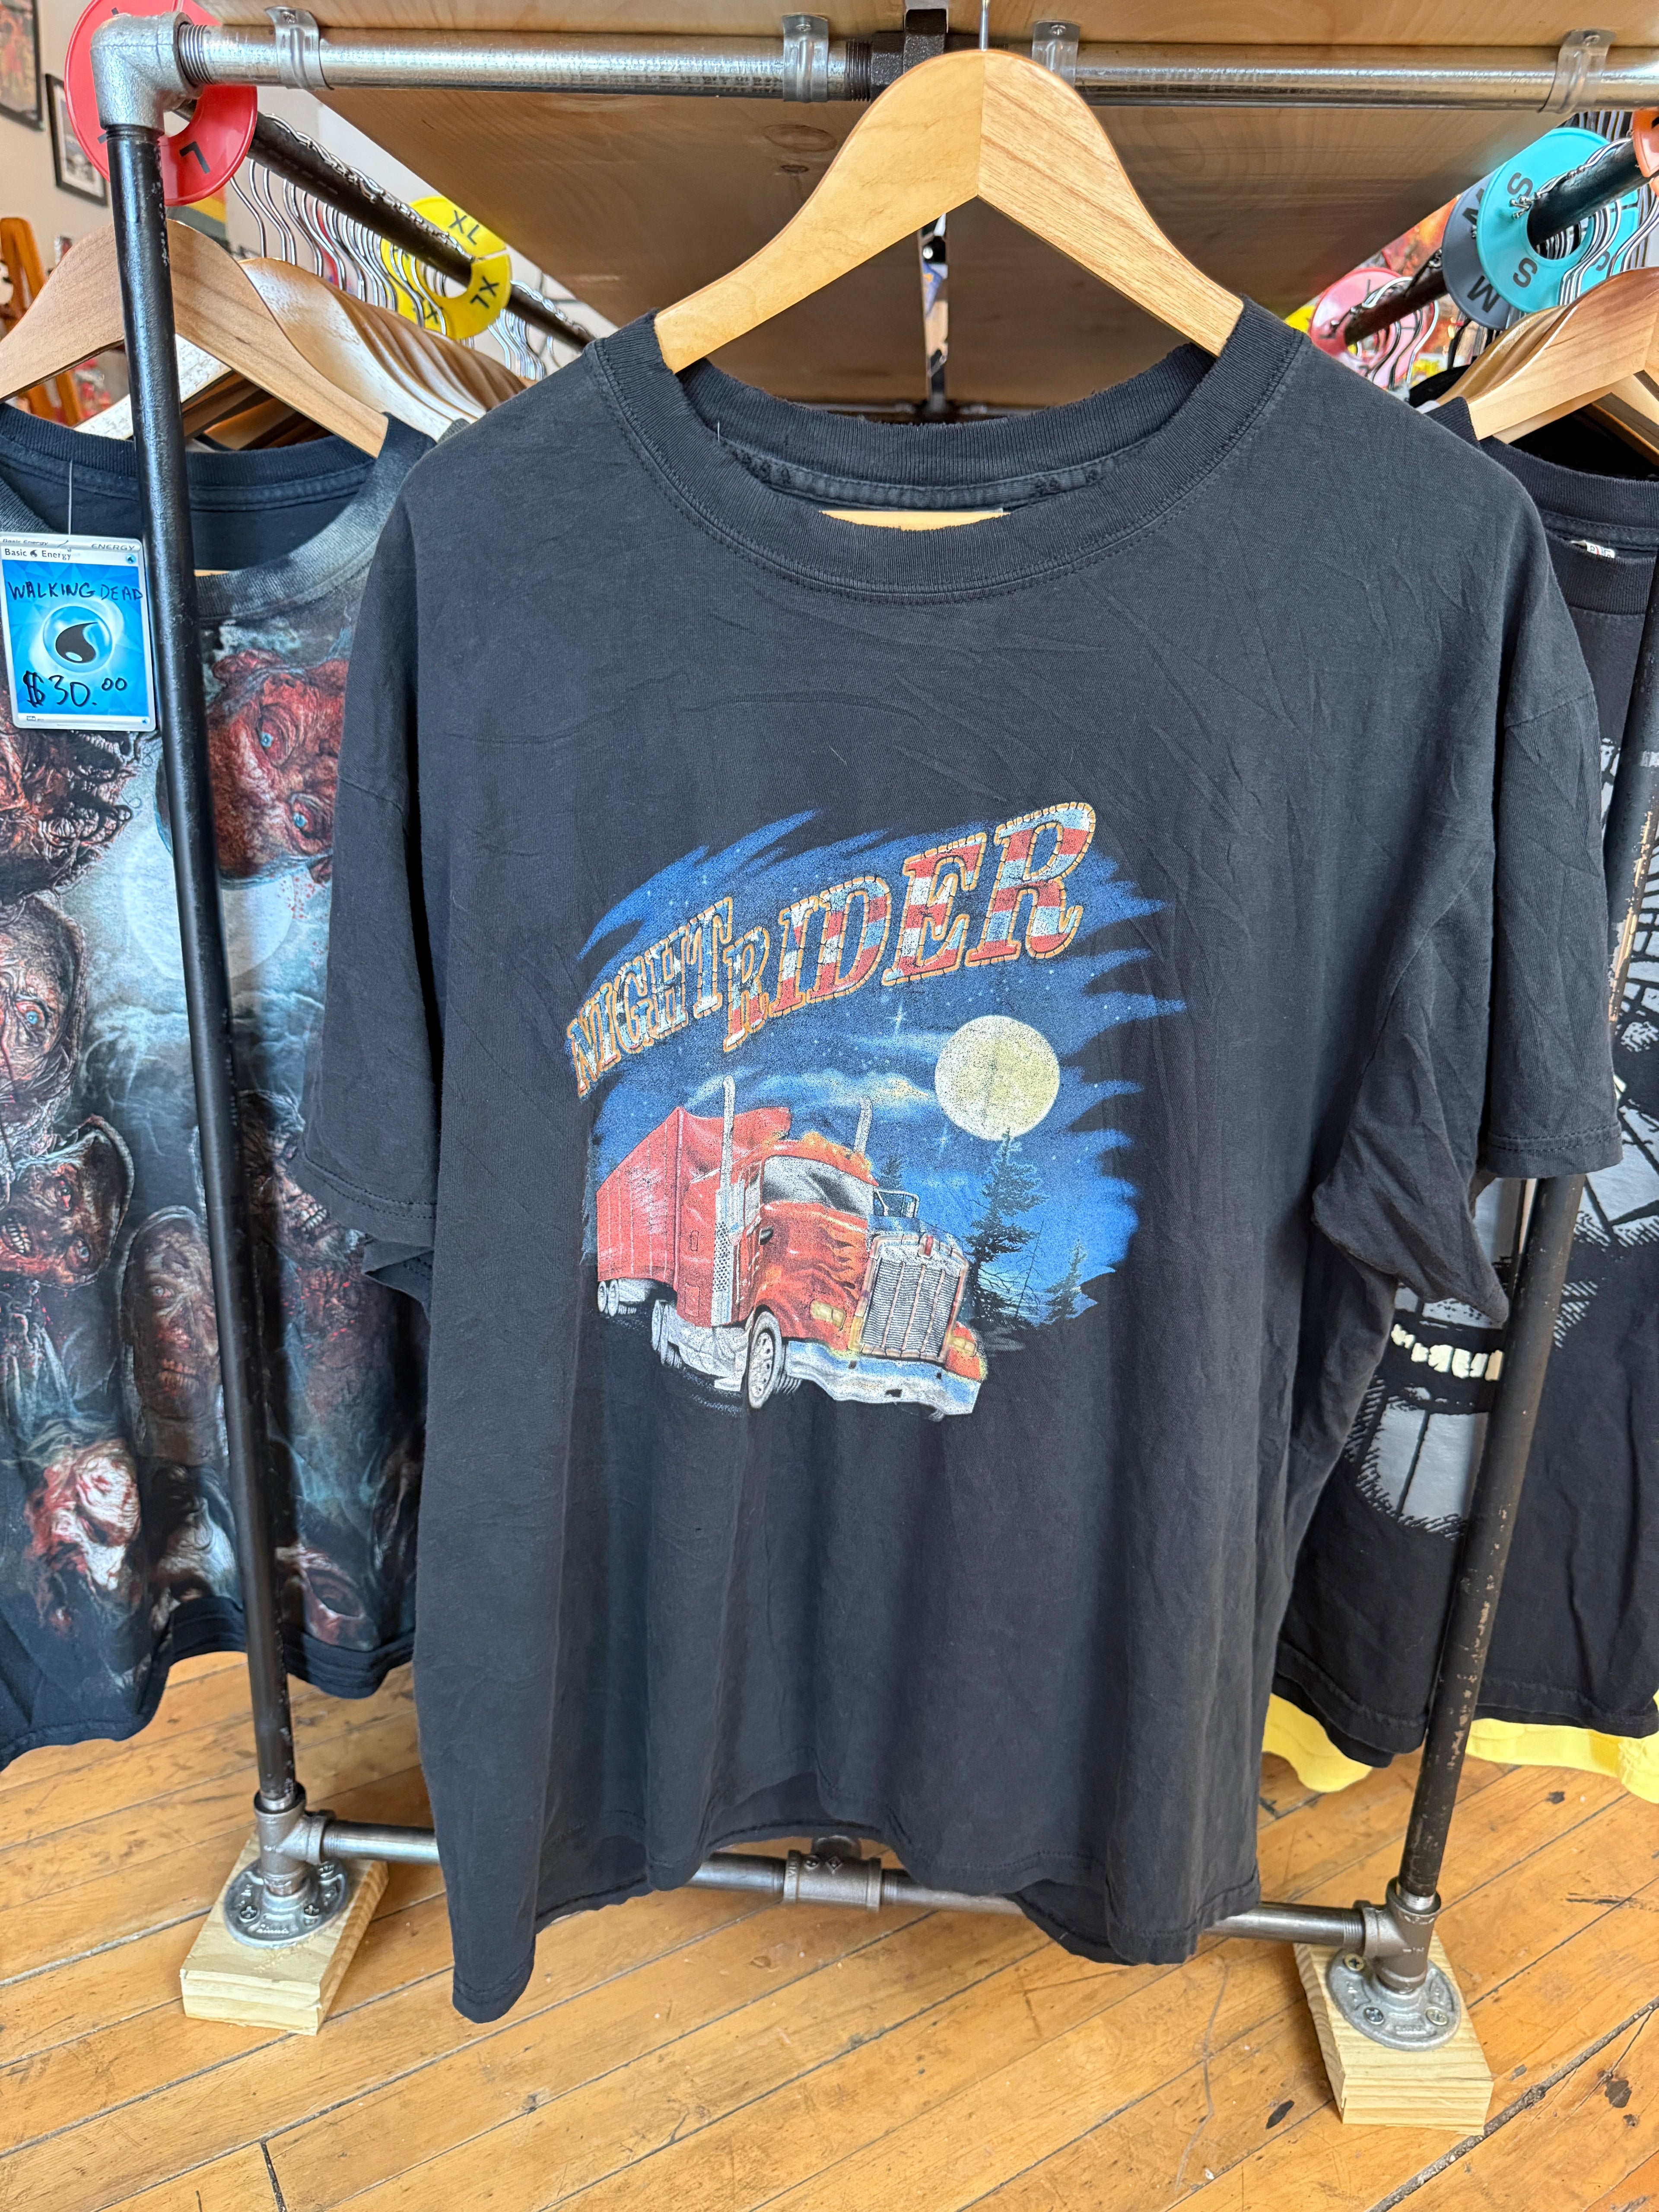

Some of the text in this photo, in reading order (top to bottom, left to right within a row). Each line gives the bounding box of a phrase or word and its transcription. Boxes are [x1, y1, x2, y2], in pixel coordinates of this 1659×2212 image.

[448, 210, 480, 245] XL
[1513, 258, 1538, 288] S
[470, 276, 500, 308] XL
[1467, 276, 1500, 313] M
[4, 548, 71, 561] Basic Energy
[91, 543, 135, 551] ENERGY
[8, 582, 143, 601] WALKING DEAD
[567, 801, 1096, 1100] NIGHT RIDER
